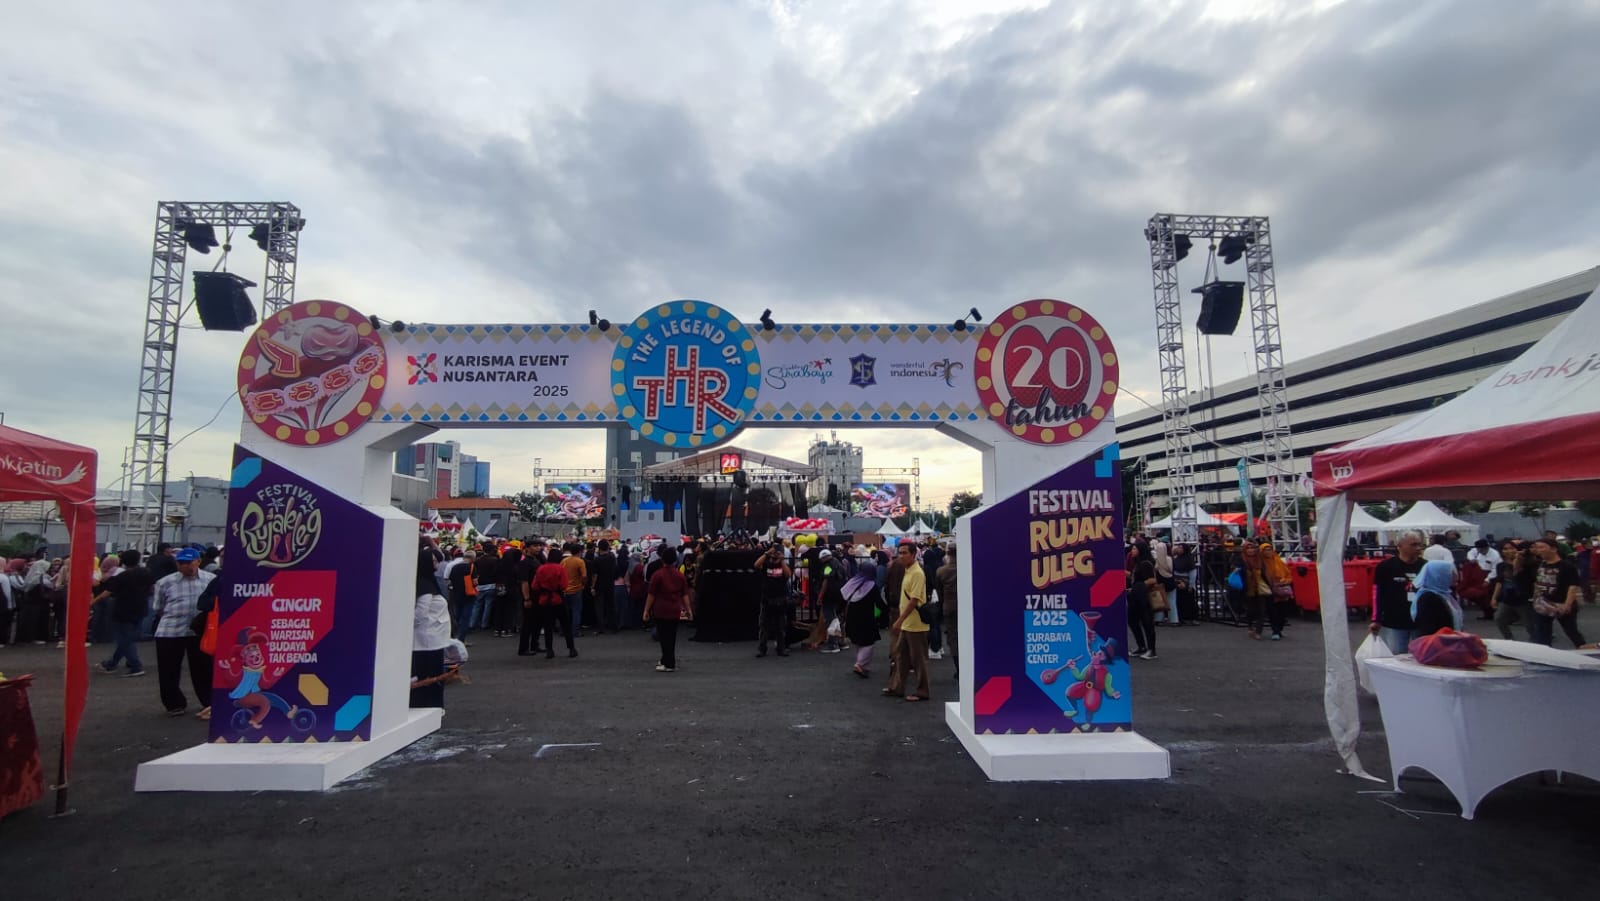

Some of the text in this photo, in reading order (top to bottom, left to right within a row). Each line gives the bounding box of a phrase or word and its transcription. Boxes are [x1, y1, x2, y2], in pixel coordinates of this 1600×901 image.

[632, 318, 742, 366] THE LEGEND OF
[444, 355, 569, 367] KARISMA EVENT
[1012, 345, 1084, 390] 20
[443, 371, 538, 383] NUSANTARA
[533, 385, 569, 397] 2025
[633, 345, 742, 435] THR
[1005, 386, 1092, 426] tahun
[256, 484, 318, 511] FESTIVAL
[1029, 490, 1113, 515] FESTIVAL
[1030, 516, 1115, 553] RUJAK
[1031, 550, 1094, 588] ULEG
[233, 583, 275, 598] RUJAK
[271, 598, 322, 612] CINGUR
[1025, 594, 1068, 610] 17 MEI
[270, 618, 311, 629] SEBAGAI
[1032, 611, 1068, 626] 2025
[270, 630, 314, 641] WARISAN
[1026, 632, 1072, 643] SURABAYA
[268, 641, 306, 652] BUDAYA
[1026, 643, 1050, 653] EXPO
[268, 653, 318, 664] TAK BENDA
[1026, 654, 1060, 665] CENTER
